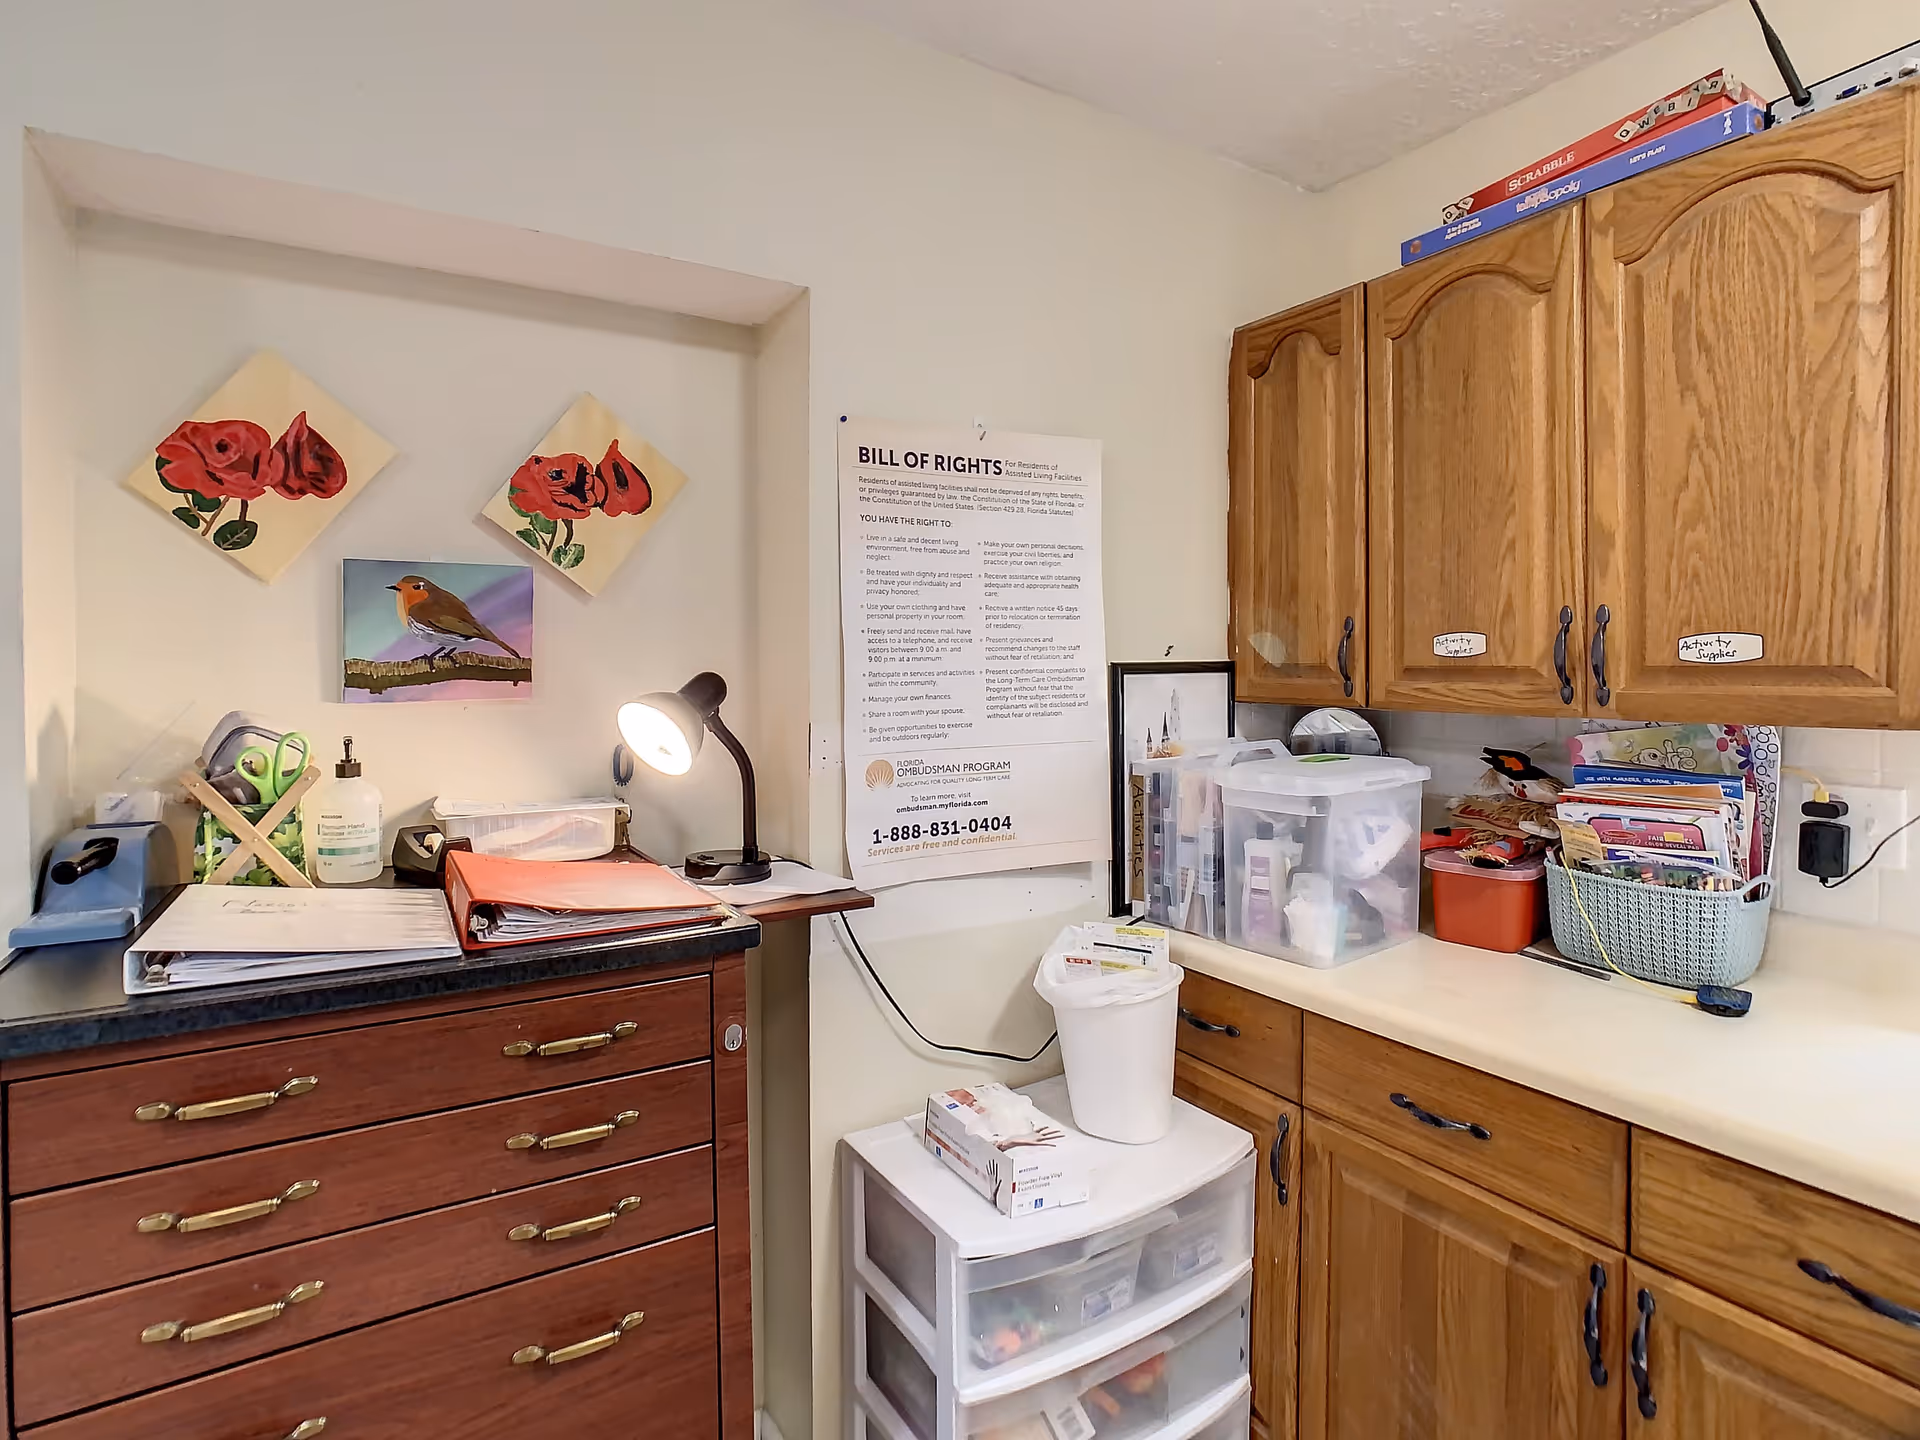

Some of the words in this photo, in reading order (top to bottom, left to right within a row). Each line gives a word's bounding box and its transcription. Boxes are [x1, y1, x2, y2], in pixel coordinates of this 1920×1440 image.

[1508, 151, 1575, 192] SCRABBLE
[859, 446, 899, 466] BILL
[904, 452, 929, 469] OF
[935, 454, 1002, 475] RIGHTS
[1005, 460, 1016, 468] For
[1018, 462, 1049, 470] Residents
[1005, 470, 1032, 478] Assisted
[1034, 472, 1052, 480] Living
[1054, 473, 1082, 481] Facilities
[859, 476, 889, 485] Residents
[897, 480, 921, 488] assisted
[922, 481, 938, 491] living
[939, 483, 962, 491] facilities
[998, 487, 1023, 496] deprived
[860, 495, 871, 503] the
[871, 496, 912, 506] Constitution
[921, 500, 931, 508] the
[933, 501, 954, 509] United
[1027, 506, 1047, 514] Florida
[868, 487, 899, 497] privileges
[900, 491, 936, 499] guaranteed
[960, 494, 971, 502] the
[972, 495, 1010, 504] Constitution
[1031, 498, 1046, 506] State
[860, 515, 877, 523] YOU
[879, 516, 898, 524] HAVE
[899, 517, 914, 525] THE
[916, 518, 939, 527] RIGHT
[1696, 649, 1736, 661] Supplies
[897, 759, 924, 767] FLORIDA
[897, 764, 960, 777] OMBUDSMAN
[963, 761, 1010, 772] PROGRAM
[897, 800, 988, 813] ombudsman.myflorida.com
[872, 816, 1011, 844] 1-888-831-0404
[1133, 784, 1144, 877] Activities
[868, 846, 903, 857] Services
[922, 840, 940, 850] free
[942, 838, 958, 847] and
